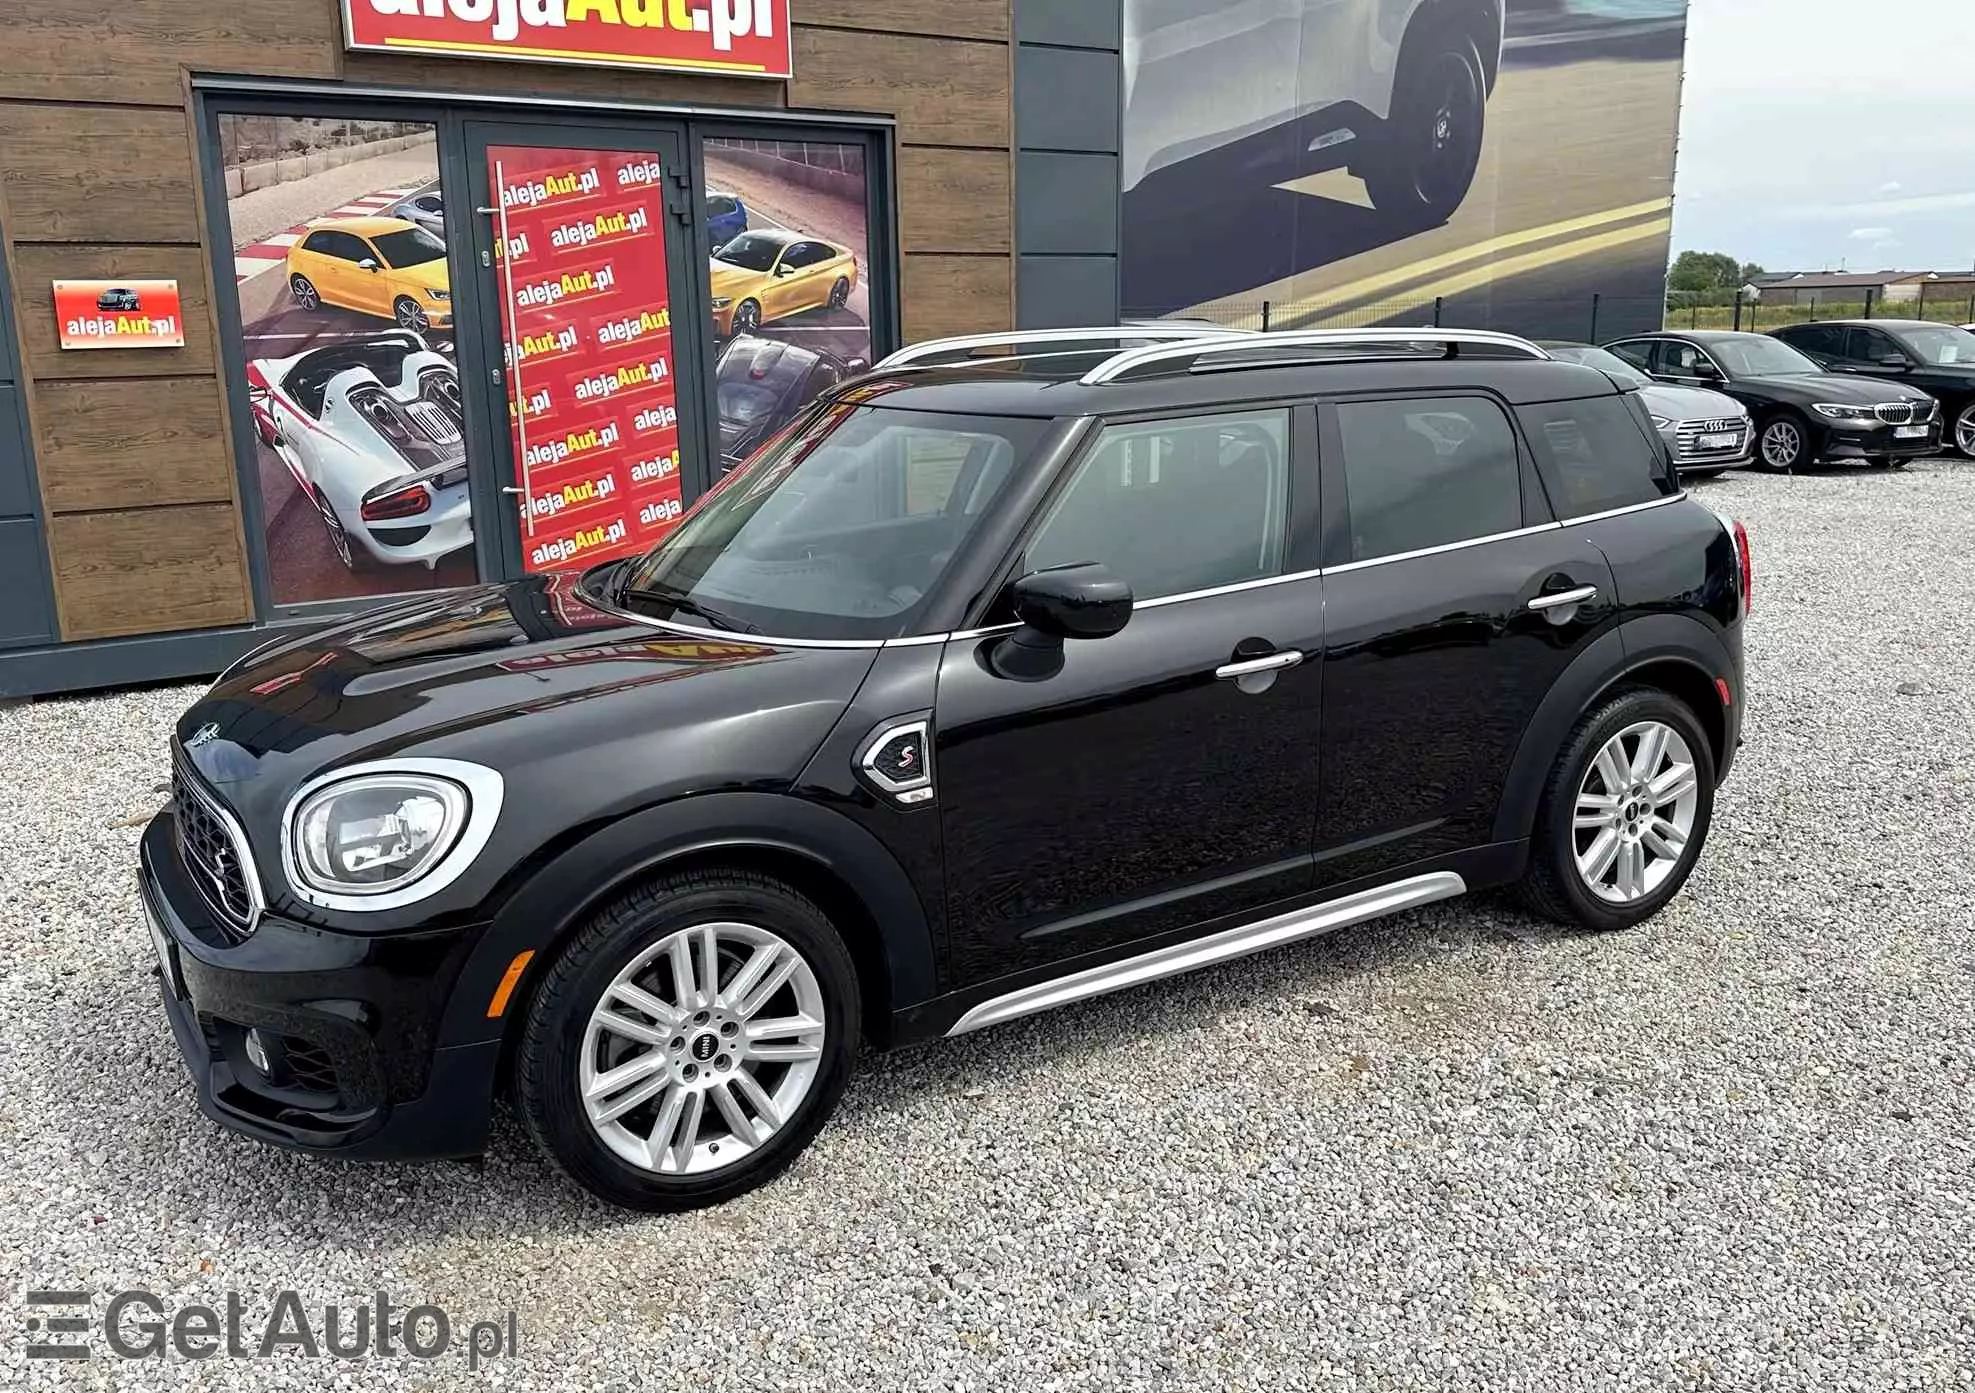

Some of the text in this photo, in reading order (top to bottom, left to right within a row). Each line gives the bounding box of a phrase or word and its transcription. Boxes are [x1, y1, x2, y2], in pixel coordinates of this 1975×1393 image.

[504, 168, 600, 207] alejaAut.pl
[551, 207, 648, 247] alejaAut.pl
[516, 265, 615, 306] alejaAut.pl
[67, 315, 176, 338] alejaAut.pl
[598, 308, 671, 343] alejaAut
[575, 357, 668, 399] alejaAut.pl
[634, 405, 676, 430] aleja
[527, 423, 619, 466] alejaAut.pl
[640, 499, 681, 523] aleja
[531, 518, 626, 564] alejaAut.pl
[898, 745, 914, 768] S
[701, 1036, 711, 1058] MINI
